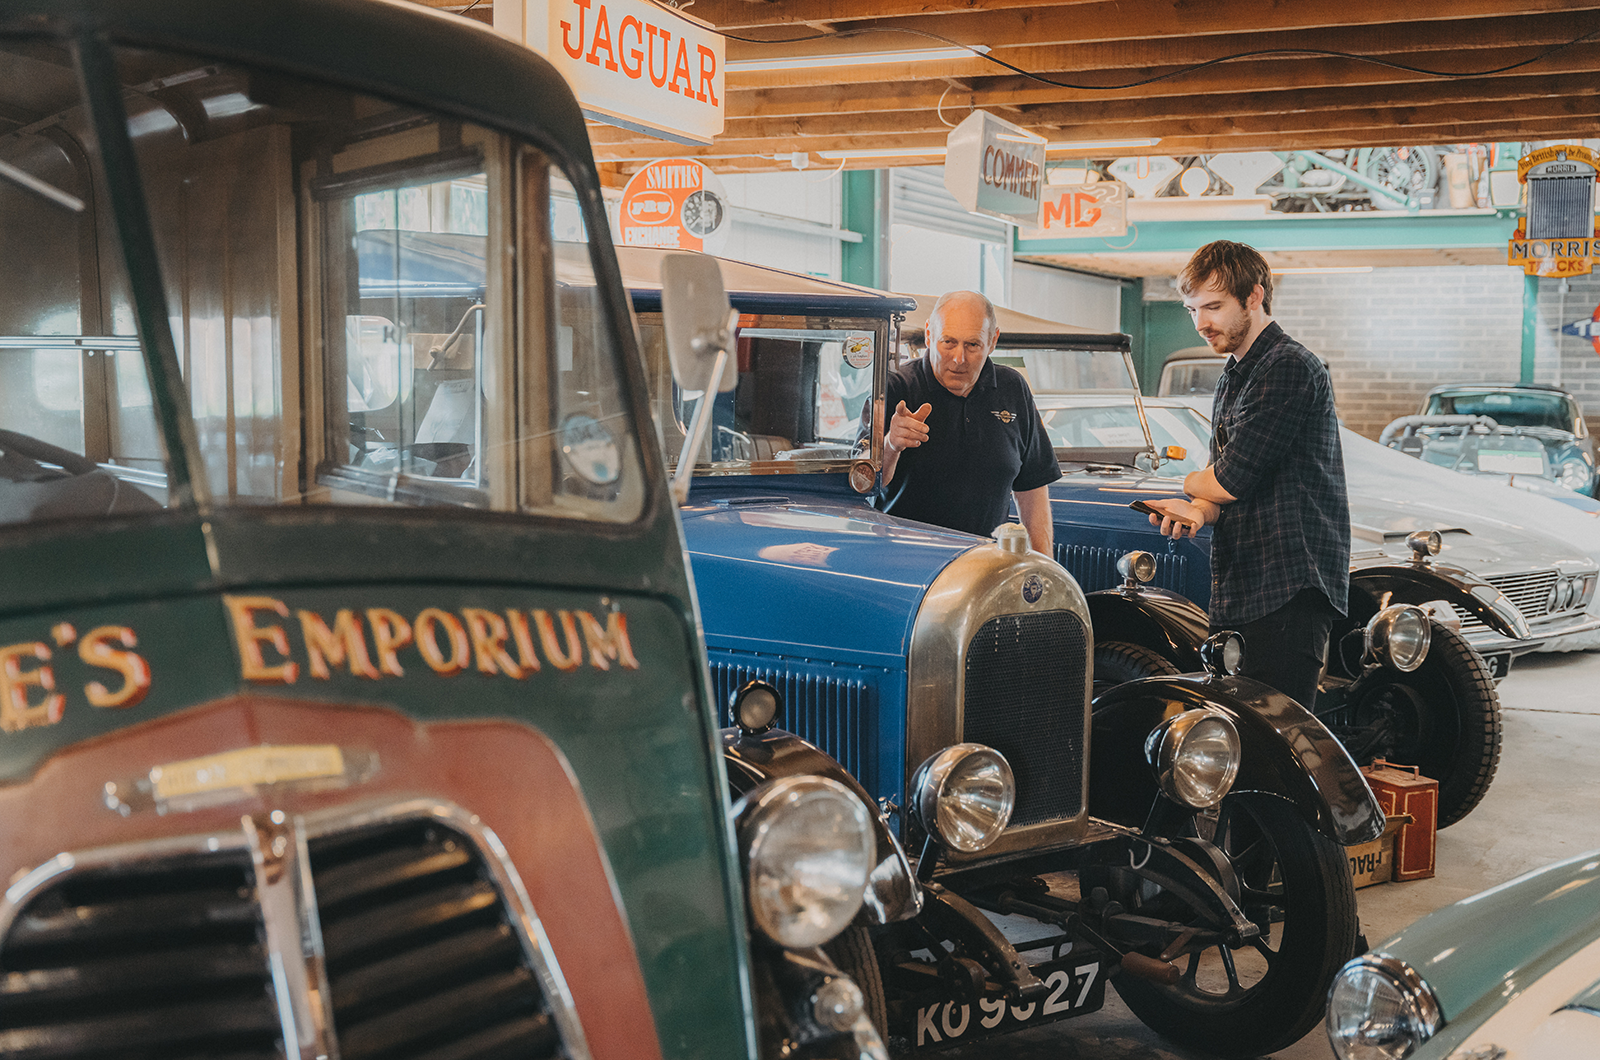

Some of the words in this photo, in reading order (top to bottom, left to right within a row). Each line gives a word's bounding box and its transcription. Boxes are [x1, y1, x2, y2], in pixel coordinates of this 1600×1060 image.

[560, 0, 719, 108] JAGUAR
[646, 165, 700, 189] SMITHS
[983, 145, 1039, 201] COMMER
[1546, 165, 1576, 173] MORRIS
[1043, 193, 1102, 229] MG
[624, 226, 680, 248] EXCHANGE
[1511, 240, 1600, 260] MORRIS
